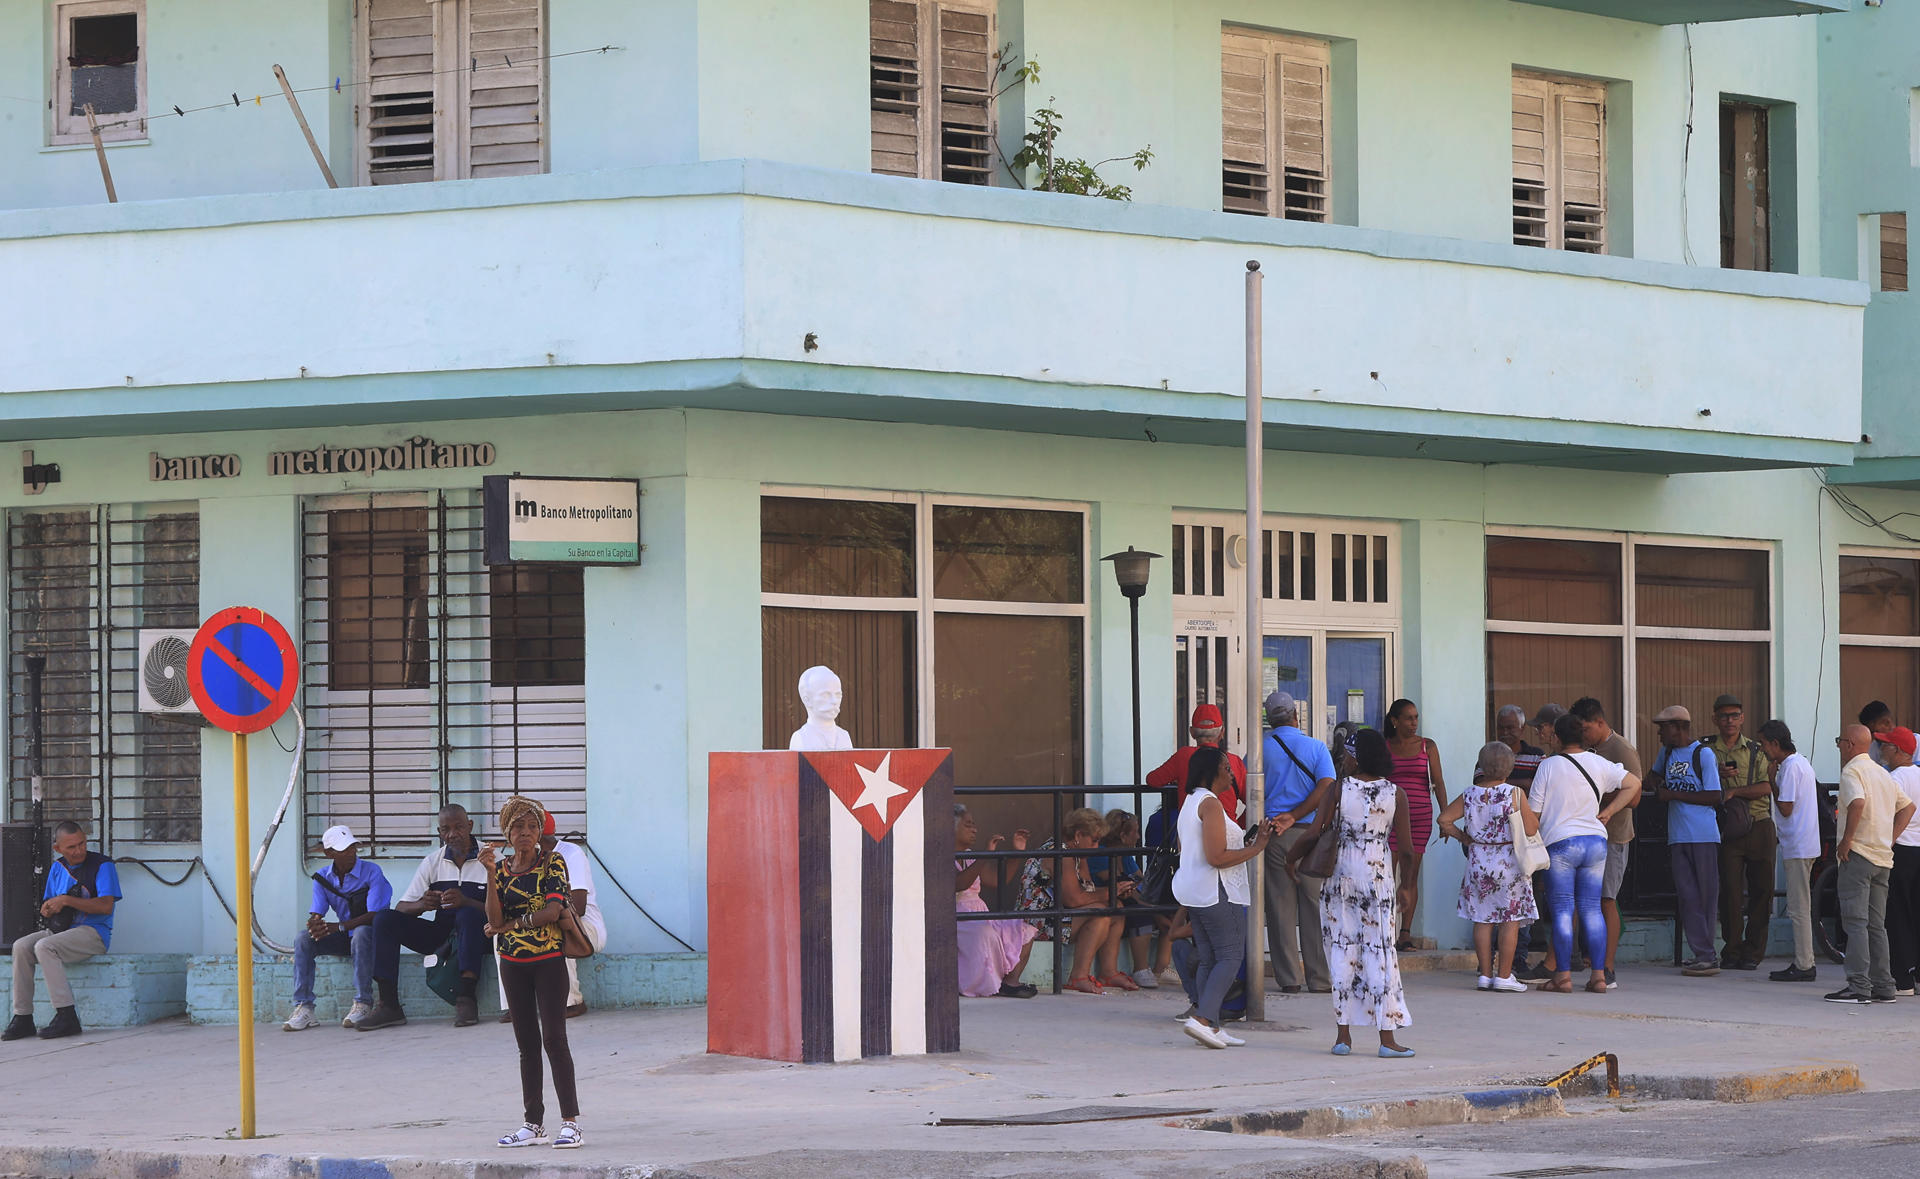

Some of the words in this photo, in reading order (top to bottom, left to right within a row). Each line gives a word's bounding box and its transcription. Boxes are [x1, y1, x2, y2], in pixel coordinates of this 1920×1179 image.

[149, 451, 241, 481] banco
[268, 435, 496, 477] metropolitano
[541, 505, 567, 519] Banco
[569, 505, 633, 522] Metropolitano
[568, 548, 576, 557] Su
[577, 548, 595, 557] Banco
[605, 548, 611, 557] la
[612, 548, 633, 559] Capital
